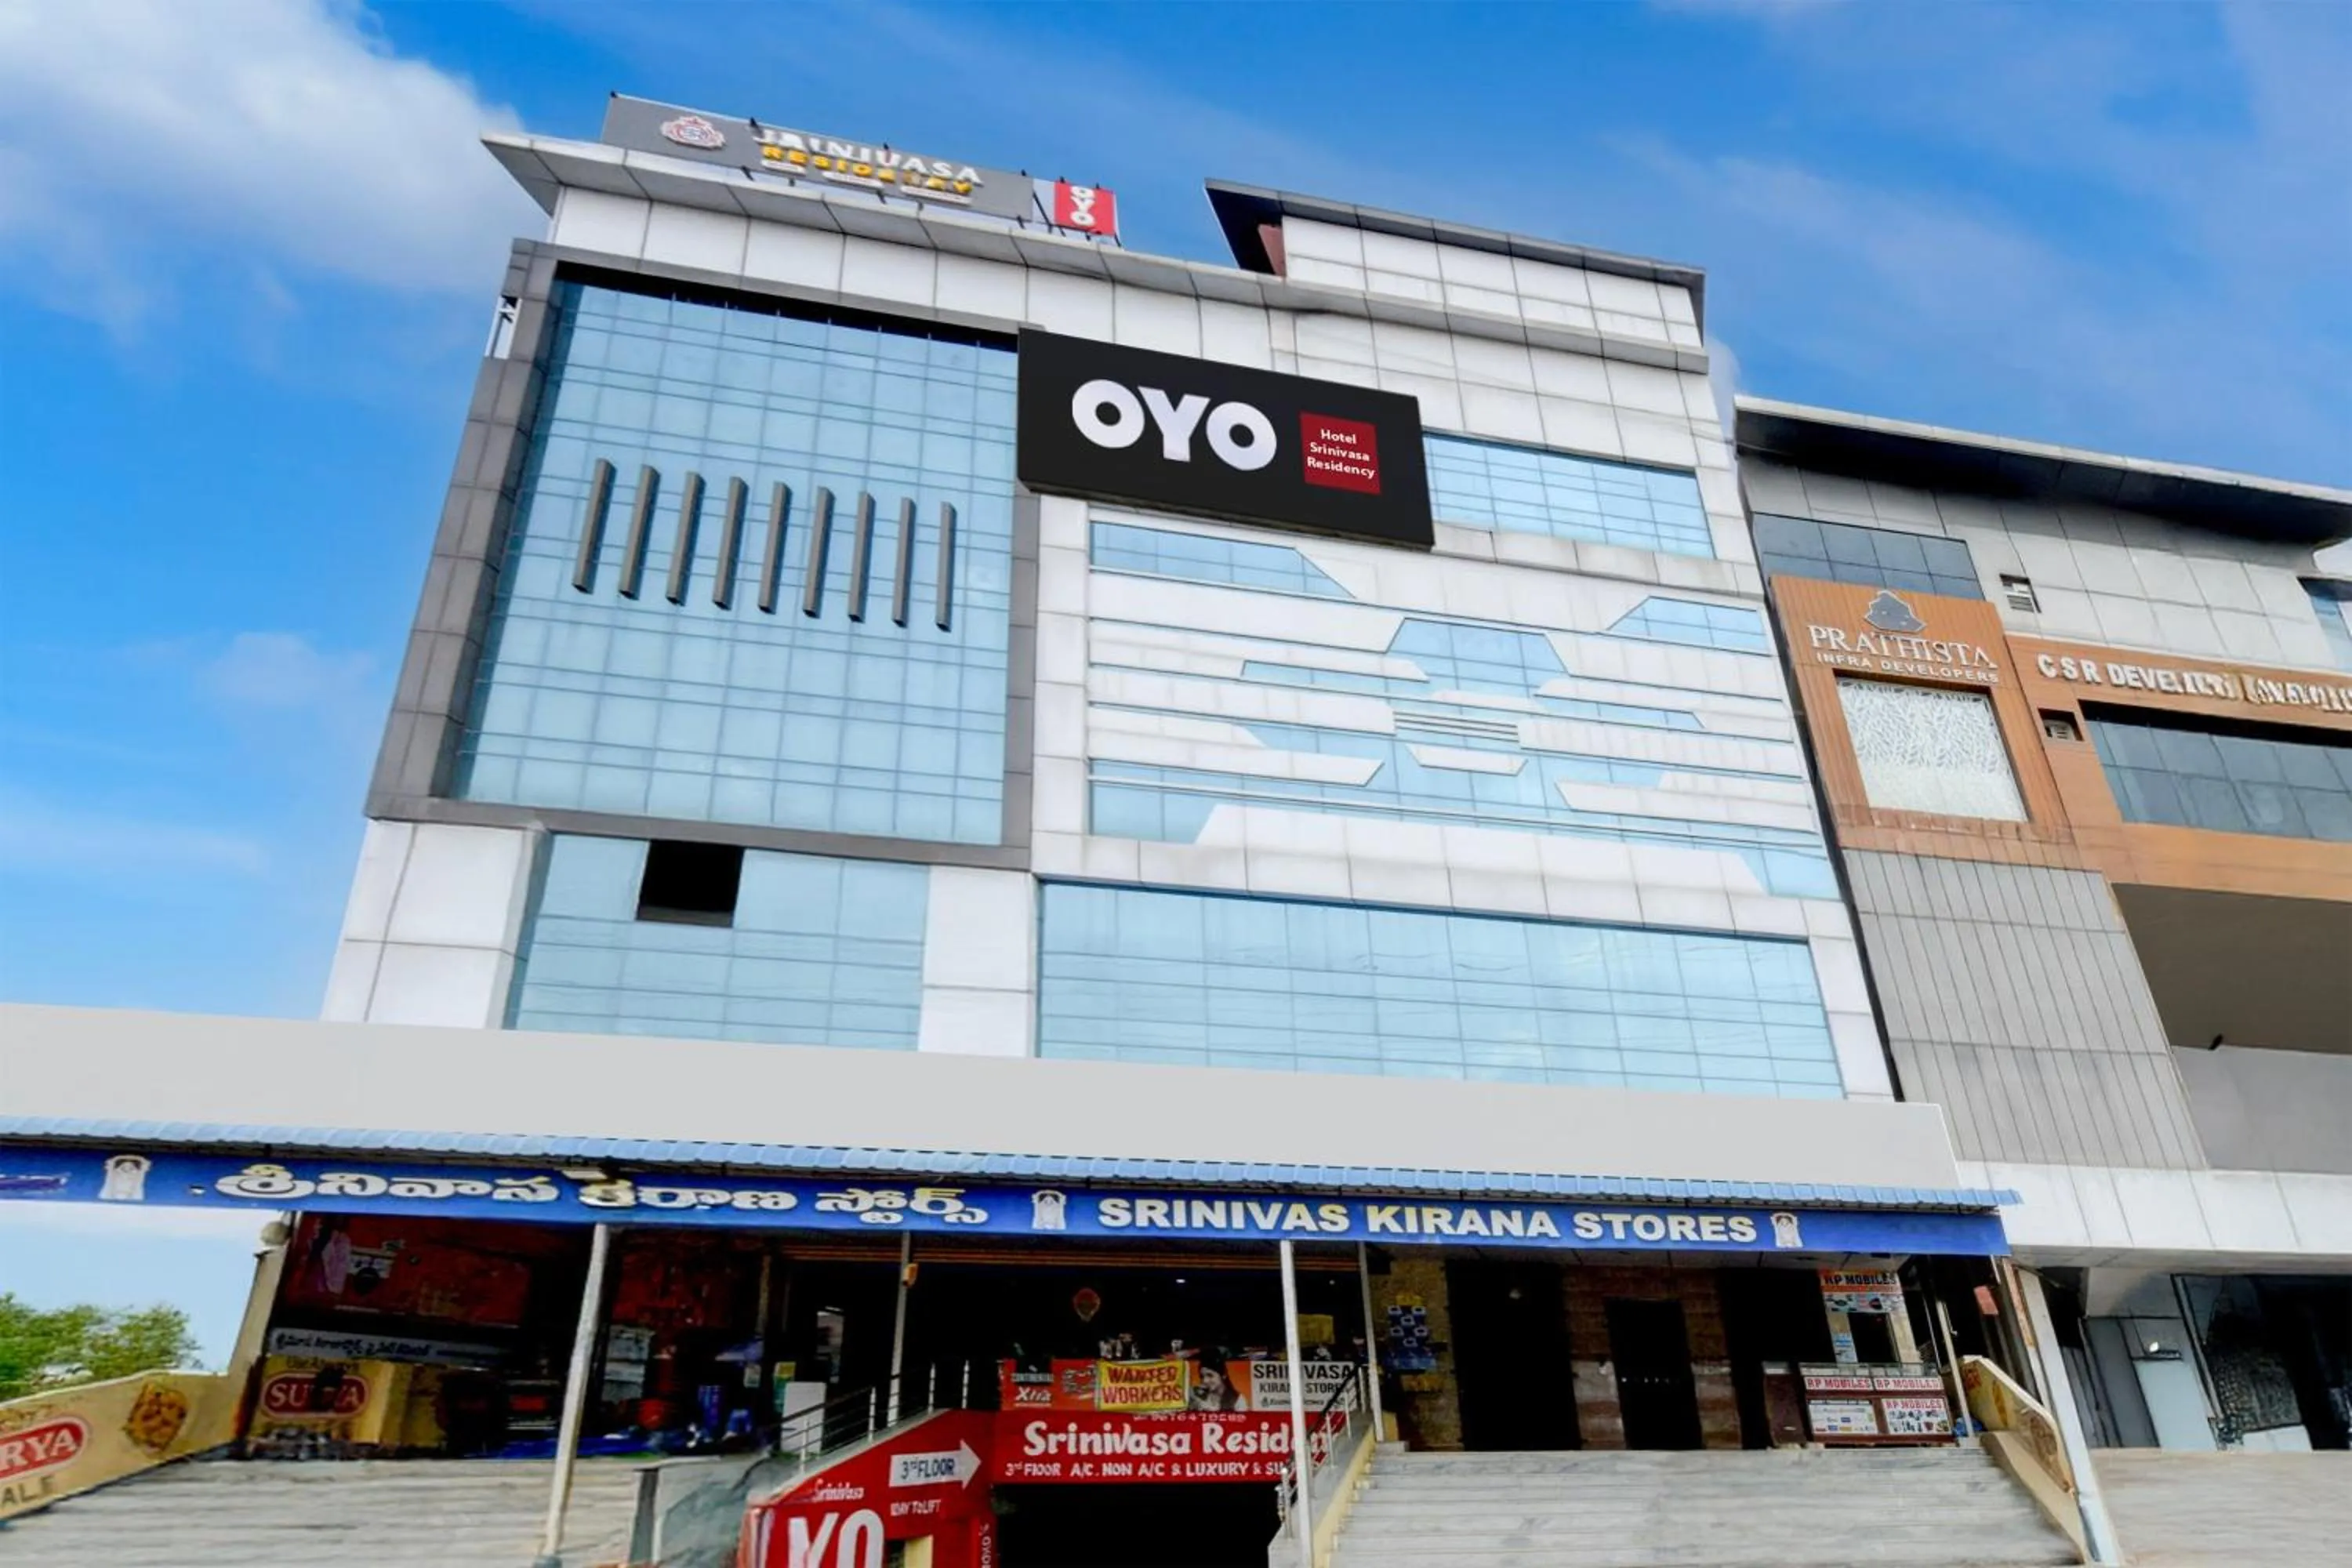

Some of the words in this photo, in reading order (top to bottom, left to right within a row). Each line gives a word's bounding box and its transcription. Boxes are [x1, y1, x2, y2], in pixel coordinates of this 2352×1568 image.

[1069, 185, 1096, 227] OYO
[1072, 379, 1277, 470] OYO
[1320, 428, 1357, 445] Hotel
[1310, 441, 1370, 462] Srinivasa
[1306, 456, 1375, 480] Residency
[1808, 625, 1998, 668] PRATHISTA
[1817, 652, 1871, 668] INFRA
[1882, 660, 1999, 684] DEVELOPERS
[1098, 1197, 1348, 1233] SRINIVAS
[1367, 1205, 1561, 1240] KIRANA
[1573, 1211, 1757, 1243] STORES
[1254, 1363, 1359, 1379] SRIVASA
[1023, 1421, 1192, 1456] Srinivasa
[1138, 1462, 1164, 1476] A/C
[1185, 1462, 1249, 1476] LUXURY
